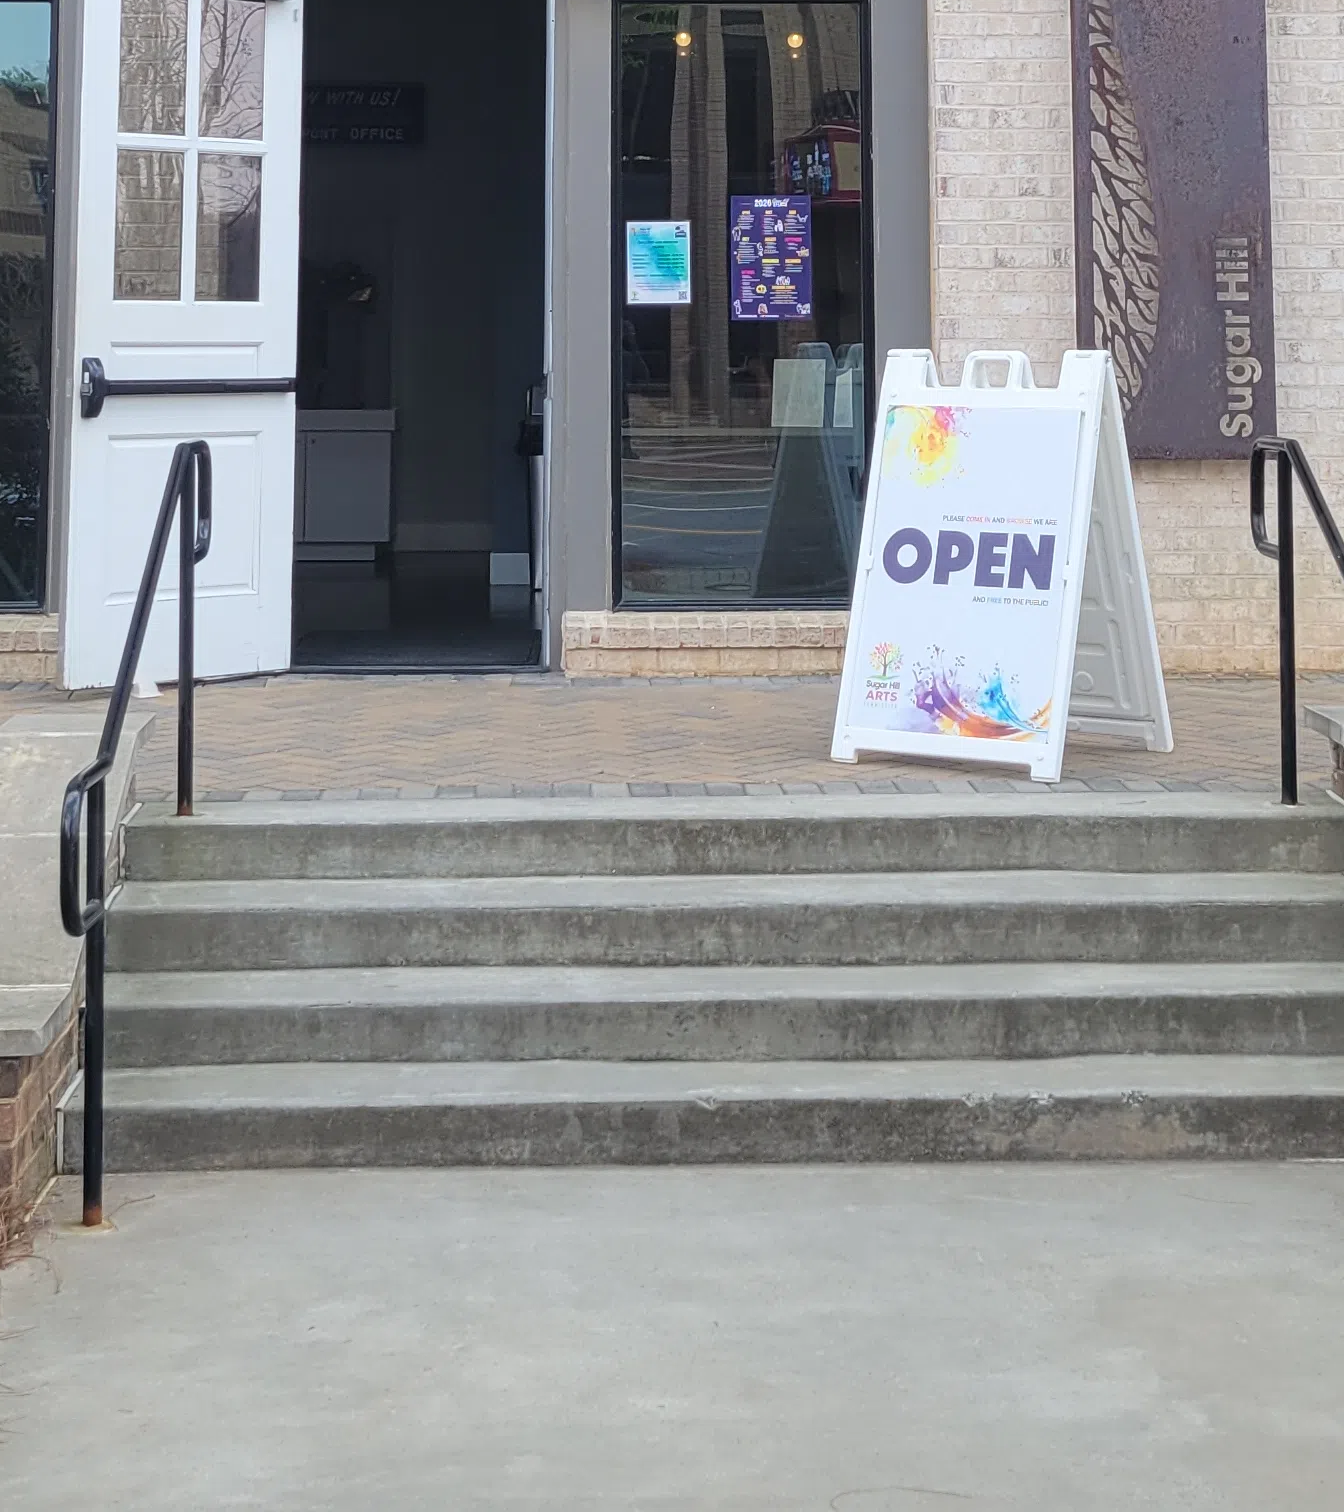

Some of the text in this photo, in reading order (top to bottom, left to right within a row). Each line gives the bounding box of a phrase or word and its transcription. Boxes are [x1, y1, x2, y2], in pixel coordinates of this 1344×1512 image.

[326, 89, 364, 105] WITH
[369, 87, 402, 106] US!
[349, 127, 405, 141] OFFICE
[1215, 236, 1263, 439] Sugar Hill
[942, 514, 965, 522] PLEASE
[882, 527, 1056, 591] OPEN
[866, 680, 888, 690] Sugar
[865, 690, 898, 702] ARTS
